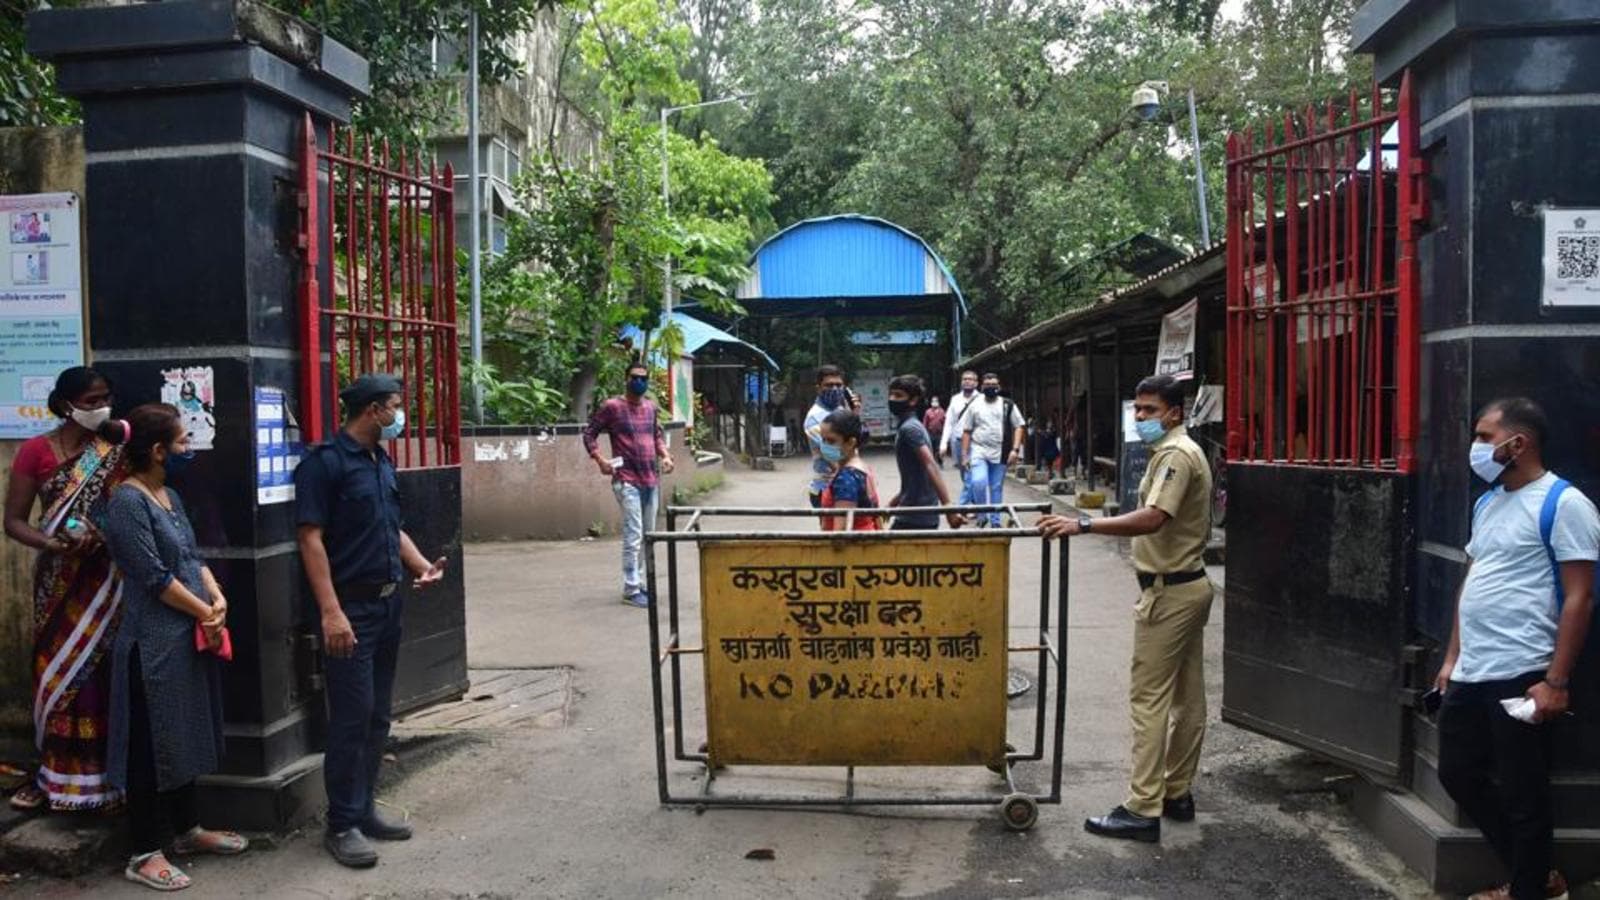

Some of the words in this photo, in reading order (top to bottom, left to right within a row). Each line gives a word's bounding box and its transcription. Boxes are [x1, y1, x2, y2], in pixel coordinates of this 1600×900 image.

[729, 564, 847, 600] कस्तुरबा
[852, 562, 984, 589] रुग्णालय
[786, 600, 870, 635] सुरक्षा
[877, 599, 922, 627] दल
[879, 631, 931, 662] प्रवेश
[740, 672, 794, 700] NO
